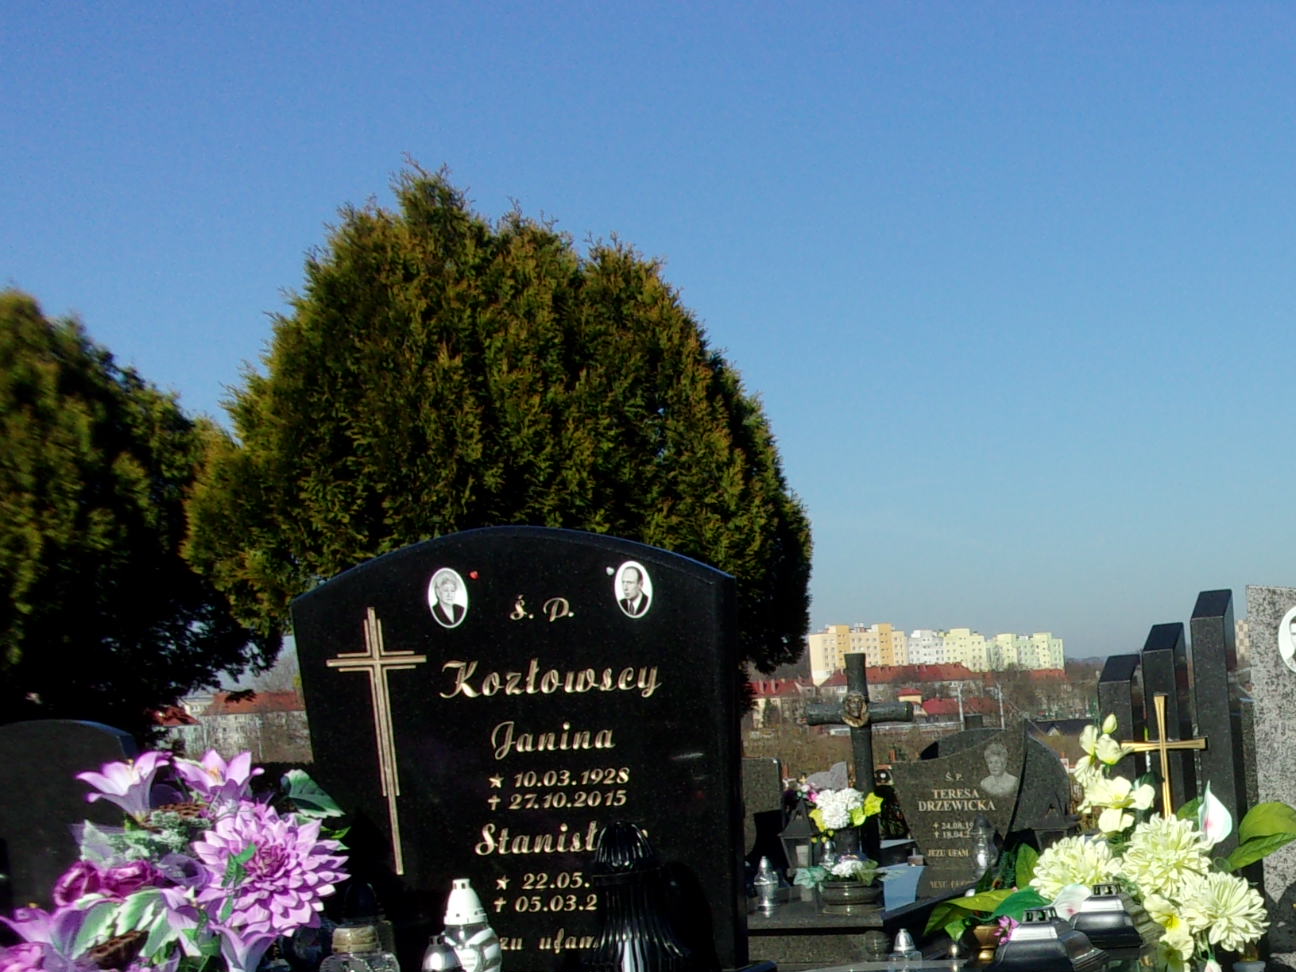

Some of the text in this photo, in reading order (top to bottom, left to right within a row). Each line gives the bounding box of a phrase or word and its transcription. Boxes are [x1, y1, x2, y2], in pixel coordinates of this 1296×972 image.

[439, 657, 663, 699] Kozłowscy
[491, 720, 616, 760] Janina
[513, 767, 630, 788] 10.03.1928
[509, 790, 627, 811] 27.10.2015
[931, 788, 980, 800] TERESA
[918, 799, 996, 812] DRZEWICKA
[474, 820, 648, 856] Stanisł
[515, 893, 598, 913] 05.03.2
